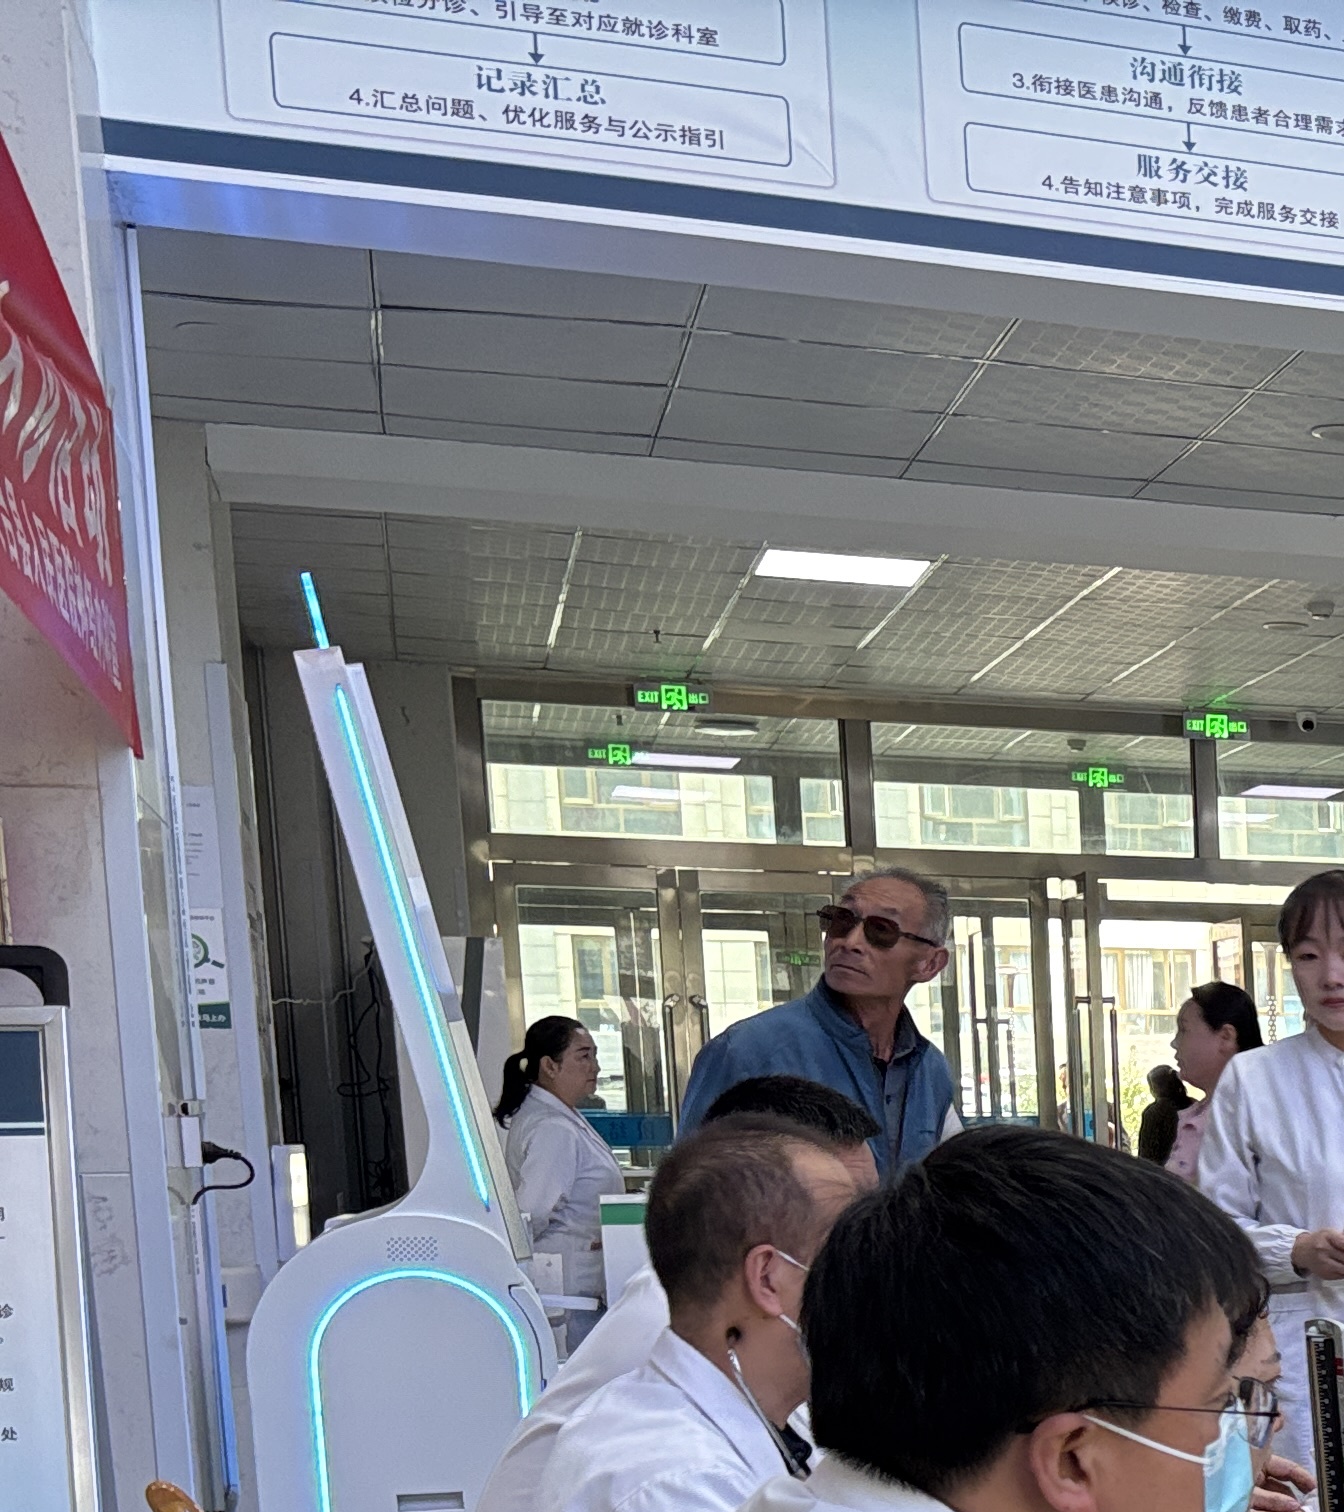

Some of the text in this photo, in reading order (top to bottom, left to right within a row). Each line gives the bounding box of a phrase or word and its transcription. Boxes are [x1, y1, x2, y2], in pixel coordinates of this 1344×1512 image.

[474, 65, 608, 105] 记录汇总
[1129, 56, 1244, 96] 沟通衔接
[348, 87, 726, 151] 4.汇总问题、优化服务与公示指引
[1135, 153, 1249, 192] 服务交接
[638, 690, 659, 703] EXIT
[1186, 719, 1204, 731] EXIT
[1, 1427, 17, 1442] 处
